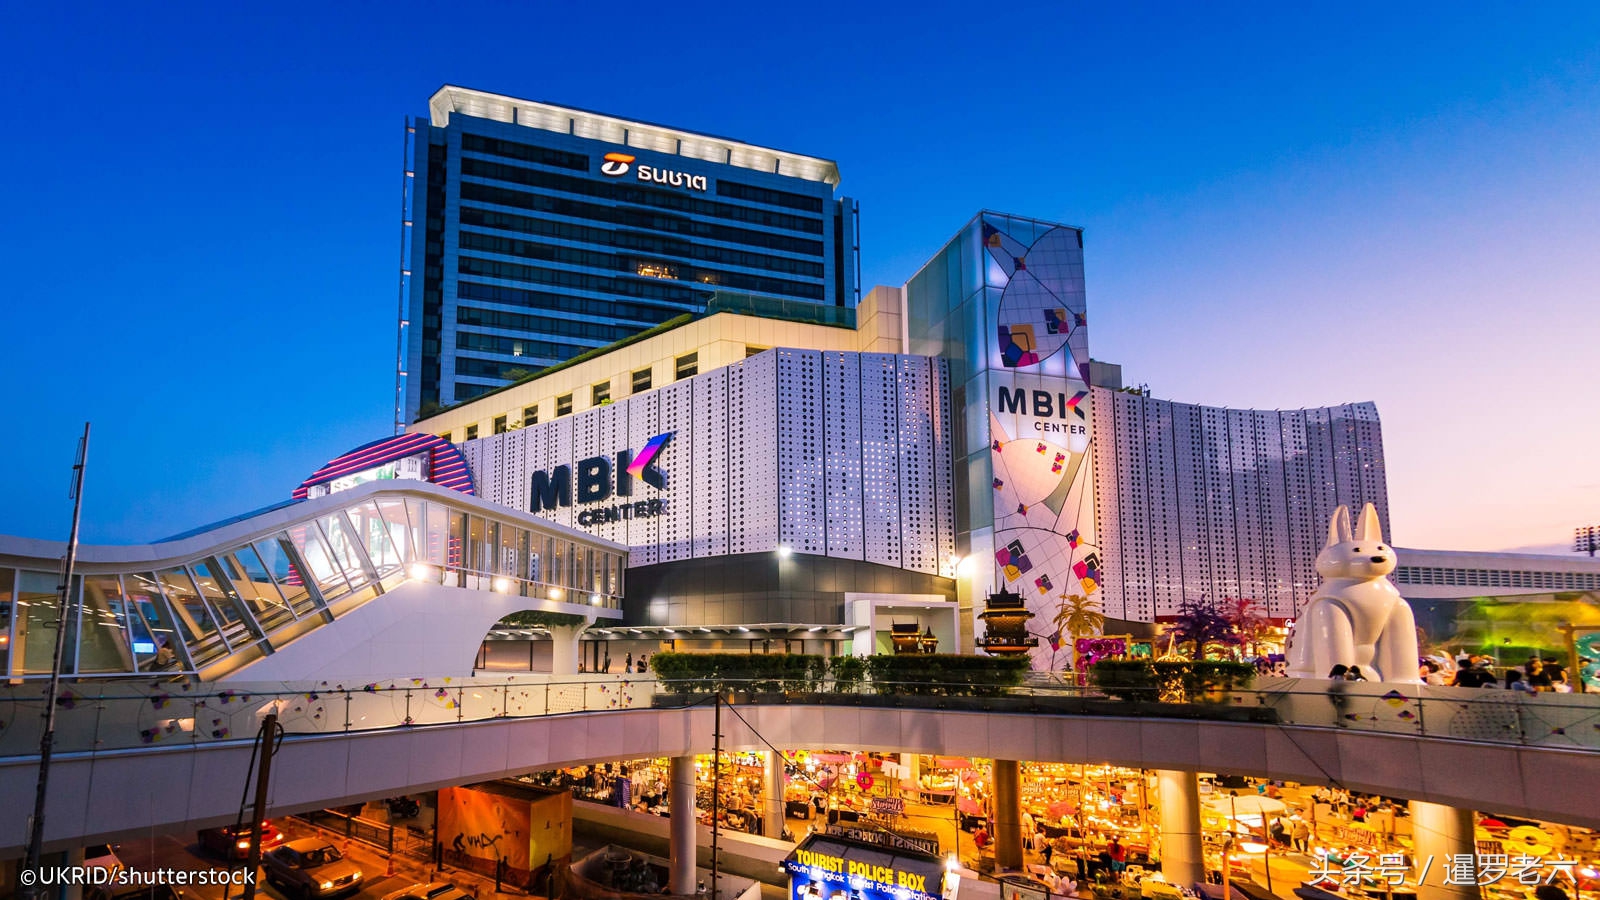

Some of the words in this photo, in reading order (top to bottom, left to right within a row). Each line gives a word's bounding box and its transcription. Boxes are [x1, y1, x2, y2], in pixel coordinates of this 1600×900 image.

[638, 165, 707, 191] ธนชาต
[998, 386, 1089, 420] MBK
[1034, 421, 1086, 435] CENTER
[530, 430, 675, 513] MBK
[577, 498, 667, 527] CENTER
[787, 862, 810, 874] South
[811, 866, 845, 883] Bngkok
[796, 849, 844, 873] TOURIST
[848, 860, 894, 885] POLICE
[898, 870, 927, 893] BOX
